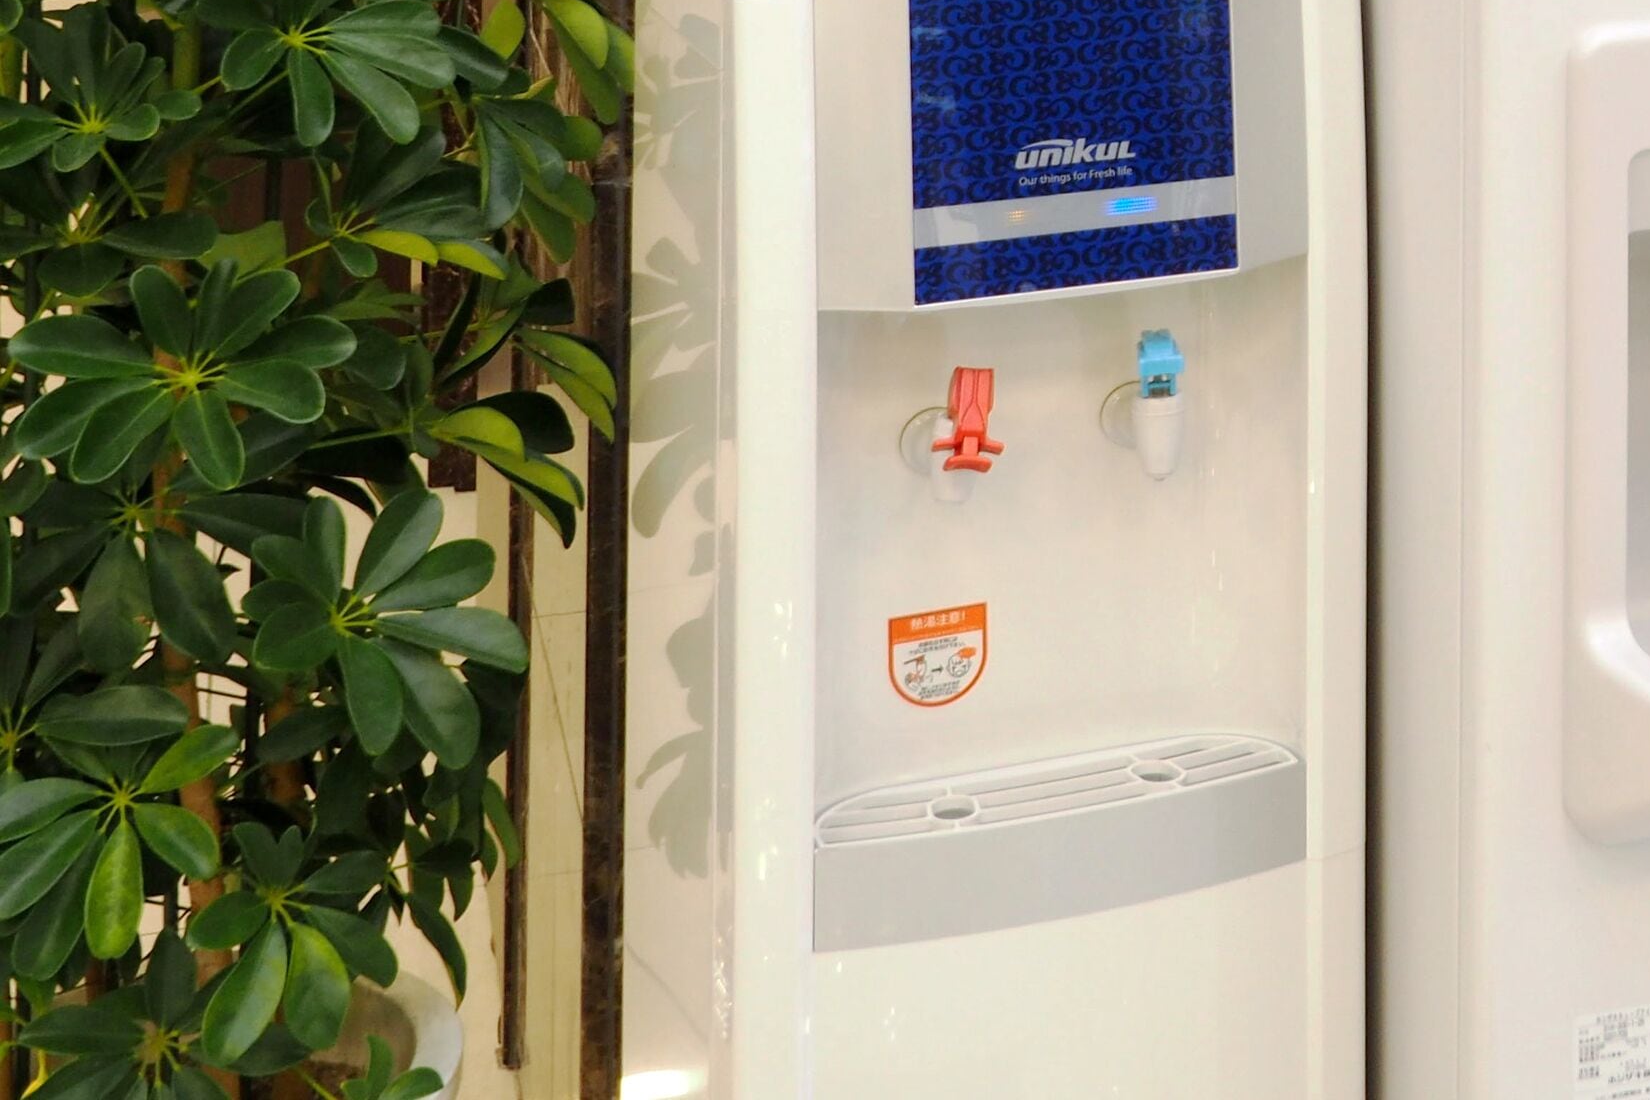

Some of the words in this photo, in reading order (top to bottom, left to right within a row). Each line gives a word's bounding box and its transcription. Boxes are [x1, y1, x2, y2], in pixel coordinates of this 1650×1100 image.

[1018, 175, 1038, 187] Our
[1039, 171, 1072, 187] things
[1073, 169, 1087, 180] for
[1088, 166, 1116, 179] Fresh
[1116, 165, 1133, 177] life
